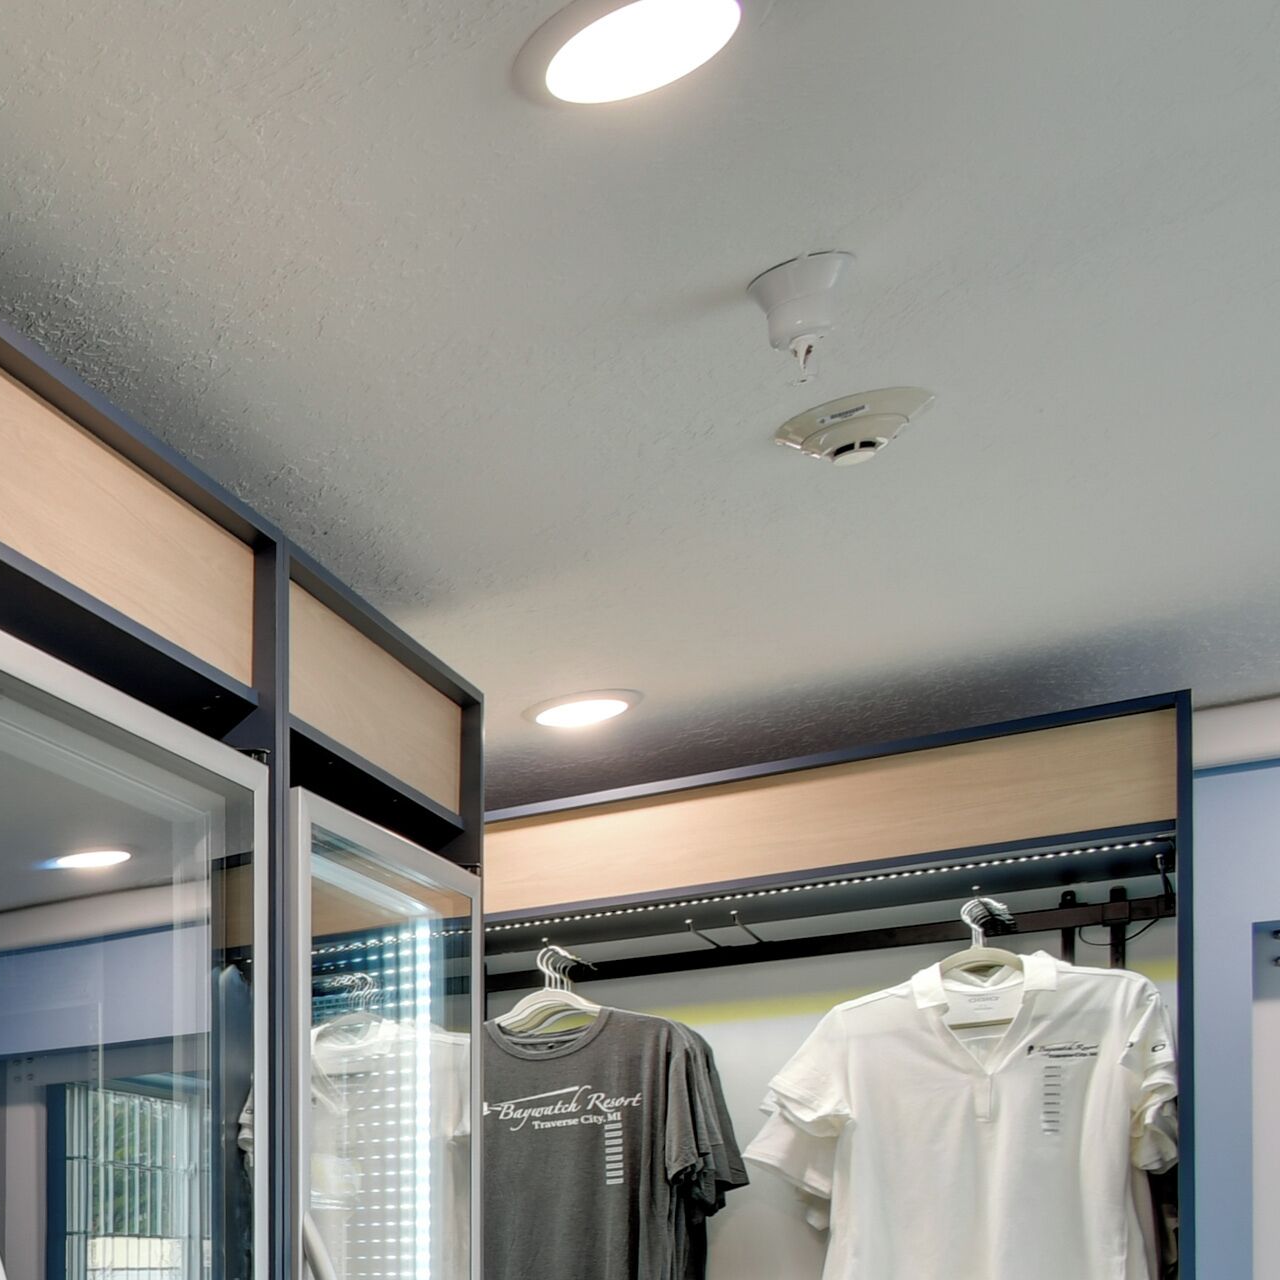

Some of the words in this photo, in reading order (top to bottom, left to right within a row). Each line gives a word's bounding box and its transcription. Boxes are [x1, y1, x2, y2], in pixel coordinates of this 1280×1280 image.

[498, 1085, 592, 1131] Baywatch
[586, 1092, 643, 1112] Resort
[532, 1118, 579, 1130] Traverse
[607, 1112, 622, 1122] MI
